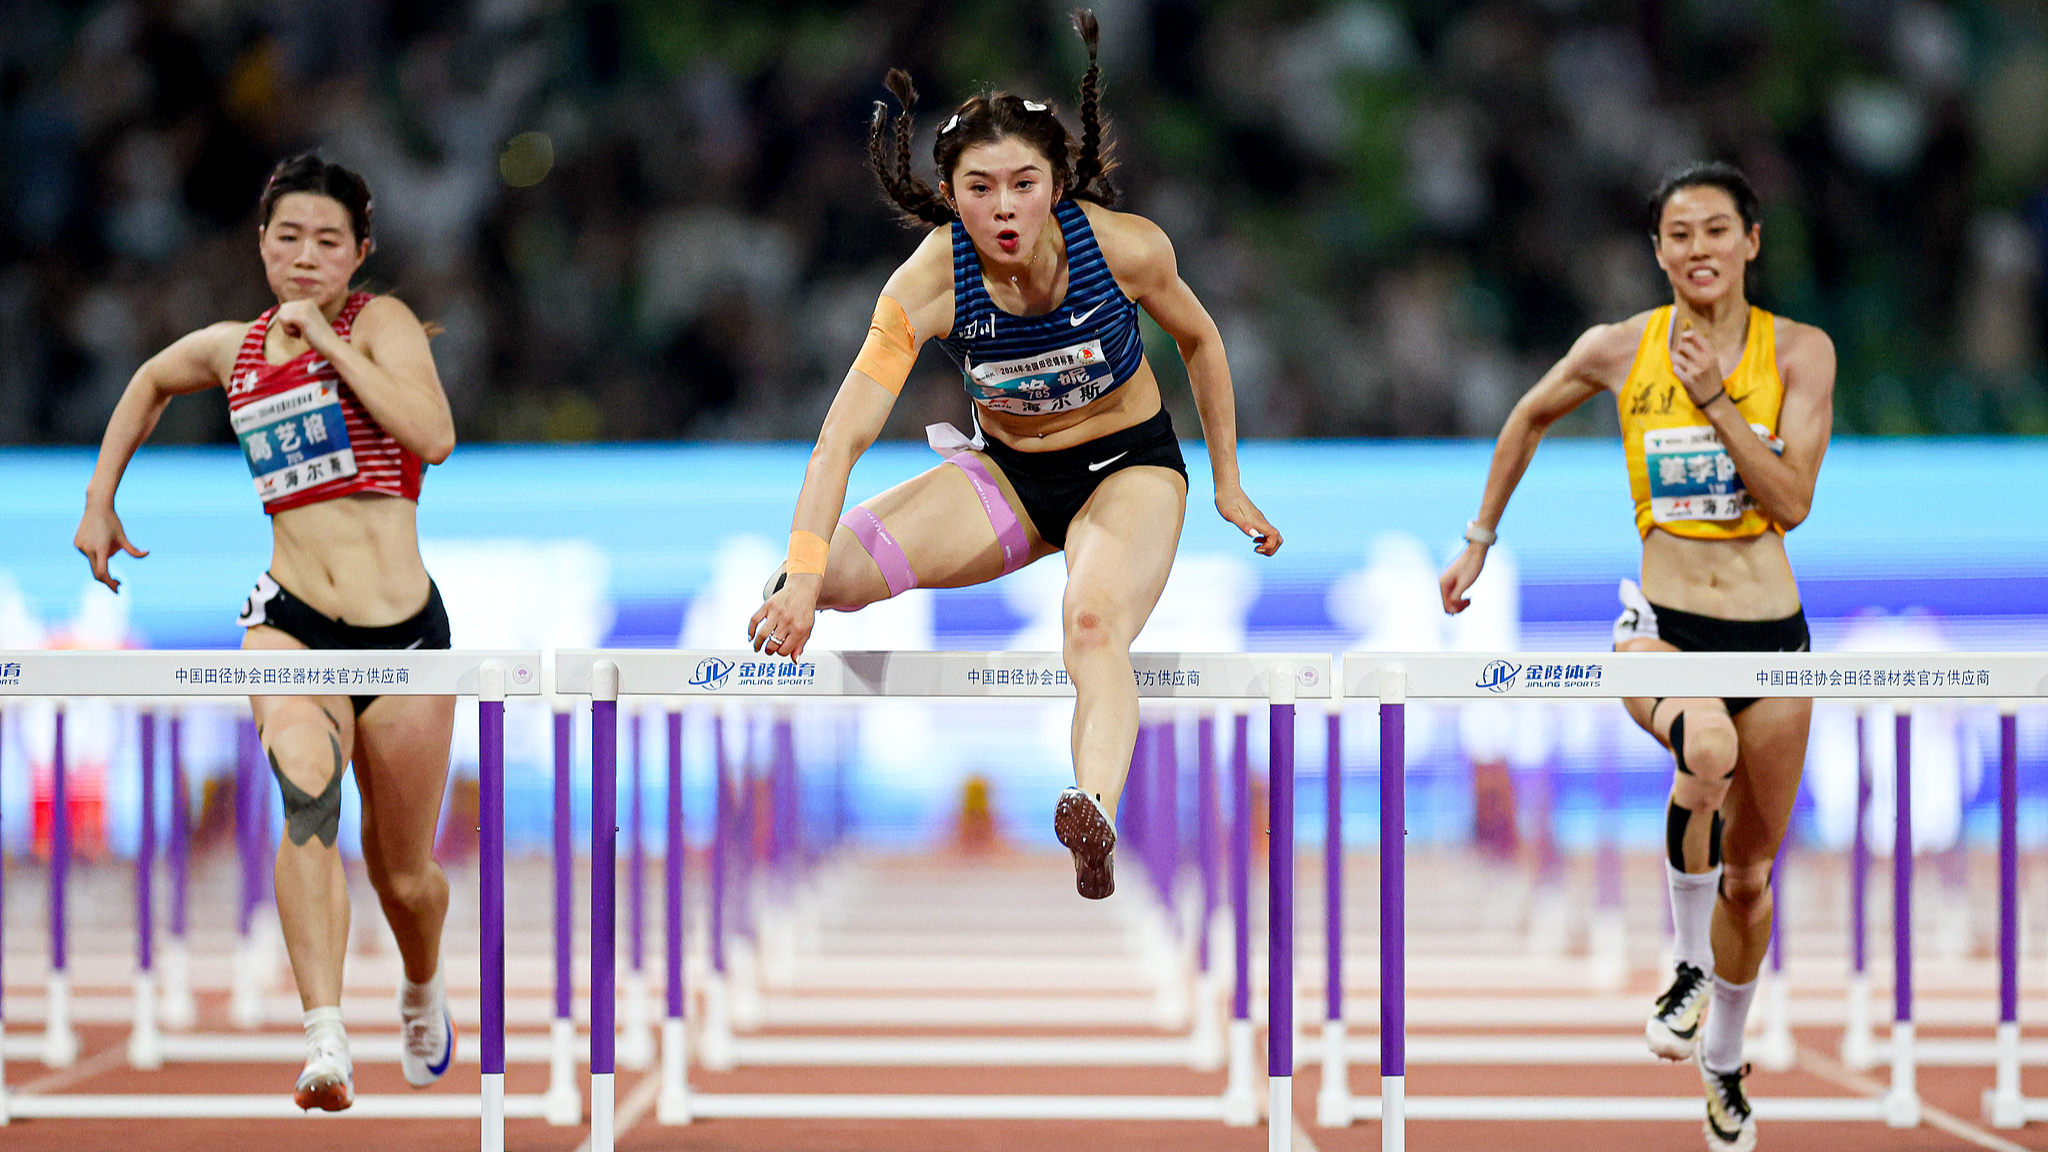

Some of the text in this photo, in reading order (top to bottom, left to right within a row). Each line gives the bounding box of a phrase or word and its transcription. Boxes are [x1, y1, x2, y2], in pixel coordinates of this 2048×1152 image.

[964, 313, 995, 339] 四川
[1022, 381, 1101, 413] 海尔斯
[1029, 389, 1051, 400] 785
[285, 456, 342, 488] 海尔斯
[176, 667, 409, 684] 中国田径协会田径器材类官方供应商
[738, 662, 816, 678] 金陵体育
[1525, 664, 1603, 680] 金陵体育
[1756, 669, 1990, 687] 中国田径协会田径器材类官方供应商
